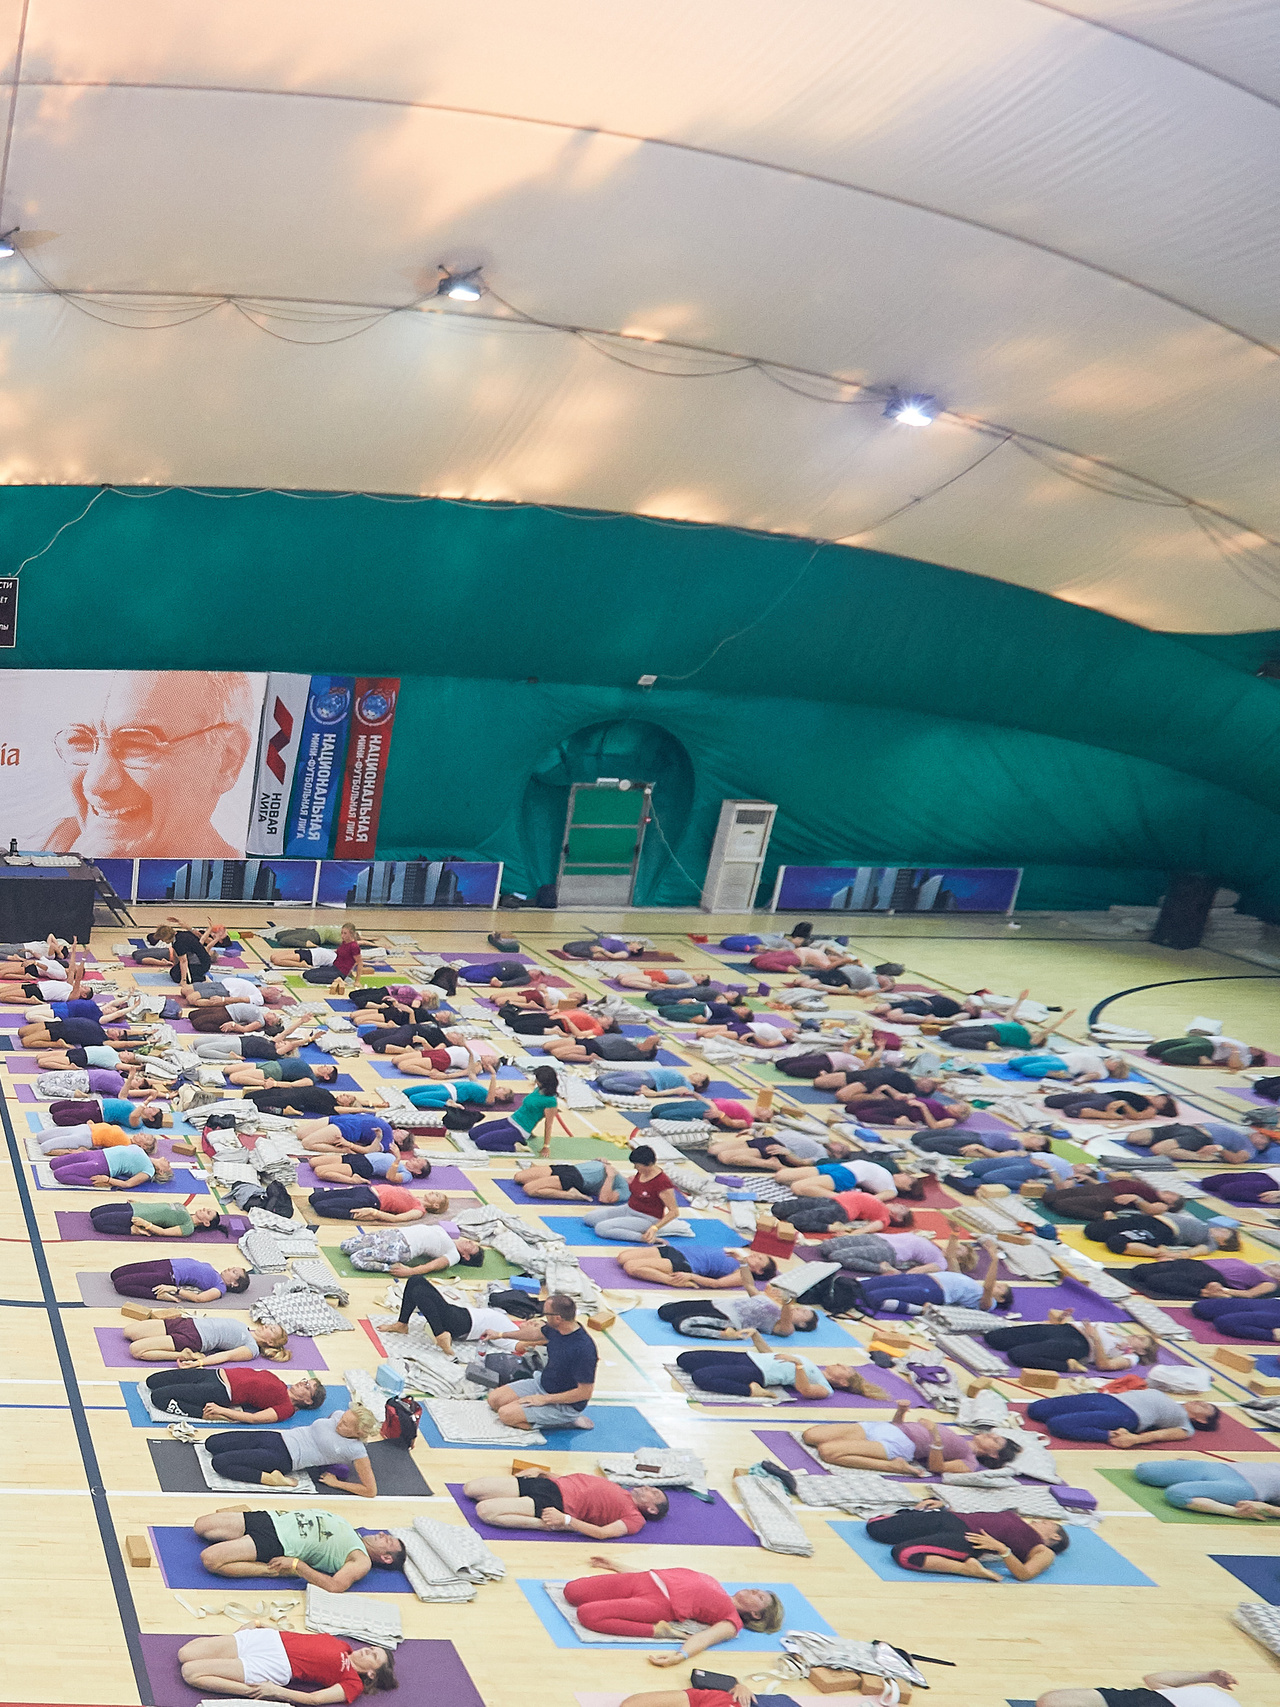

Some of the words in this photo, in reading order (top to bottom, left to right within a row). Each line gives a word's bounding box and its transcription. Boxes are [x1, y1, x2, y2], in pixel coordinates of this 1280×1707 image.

[300, 732, 320, 815] МИНИ-ФУТБОЛЬНАЯ
[307, 733, 337, 841] НАЦИОНАЛЬНАЯ
[348, 734, 367, 818] МИНИ-ФУТБОЛЬНАЯ
[355, 734, 383, 843] НАЦИОНАЛЬНАЯ
[258, 792, 271, 823] ЛИГА
[266, 792, 282, 835] НОВАЯ
[296, 817, 308, 839] ЛИГА
[345, 820, 356, 842] ЛИГА
